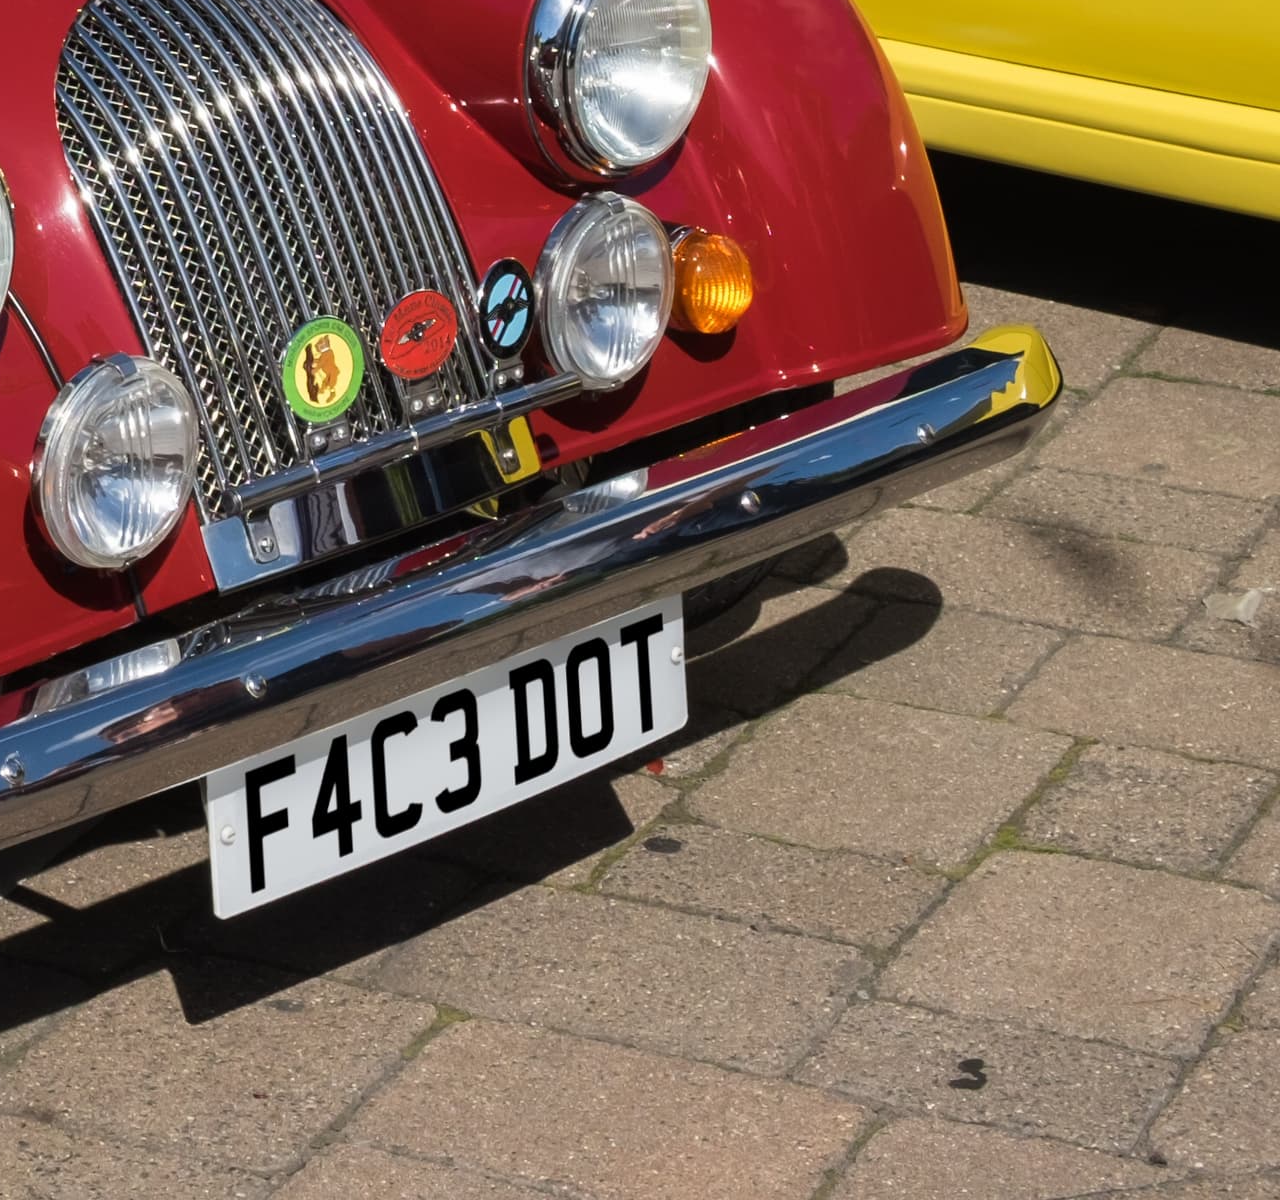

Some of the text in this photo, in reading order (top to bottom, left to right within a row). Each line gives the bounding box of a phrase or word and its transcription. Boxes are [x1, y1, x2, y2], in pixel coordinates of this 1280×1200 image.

[424, 333, 451, 354] 2014
[245, 613, 663, 894] F4C3 DOT
